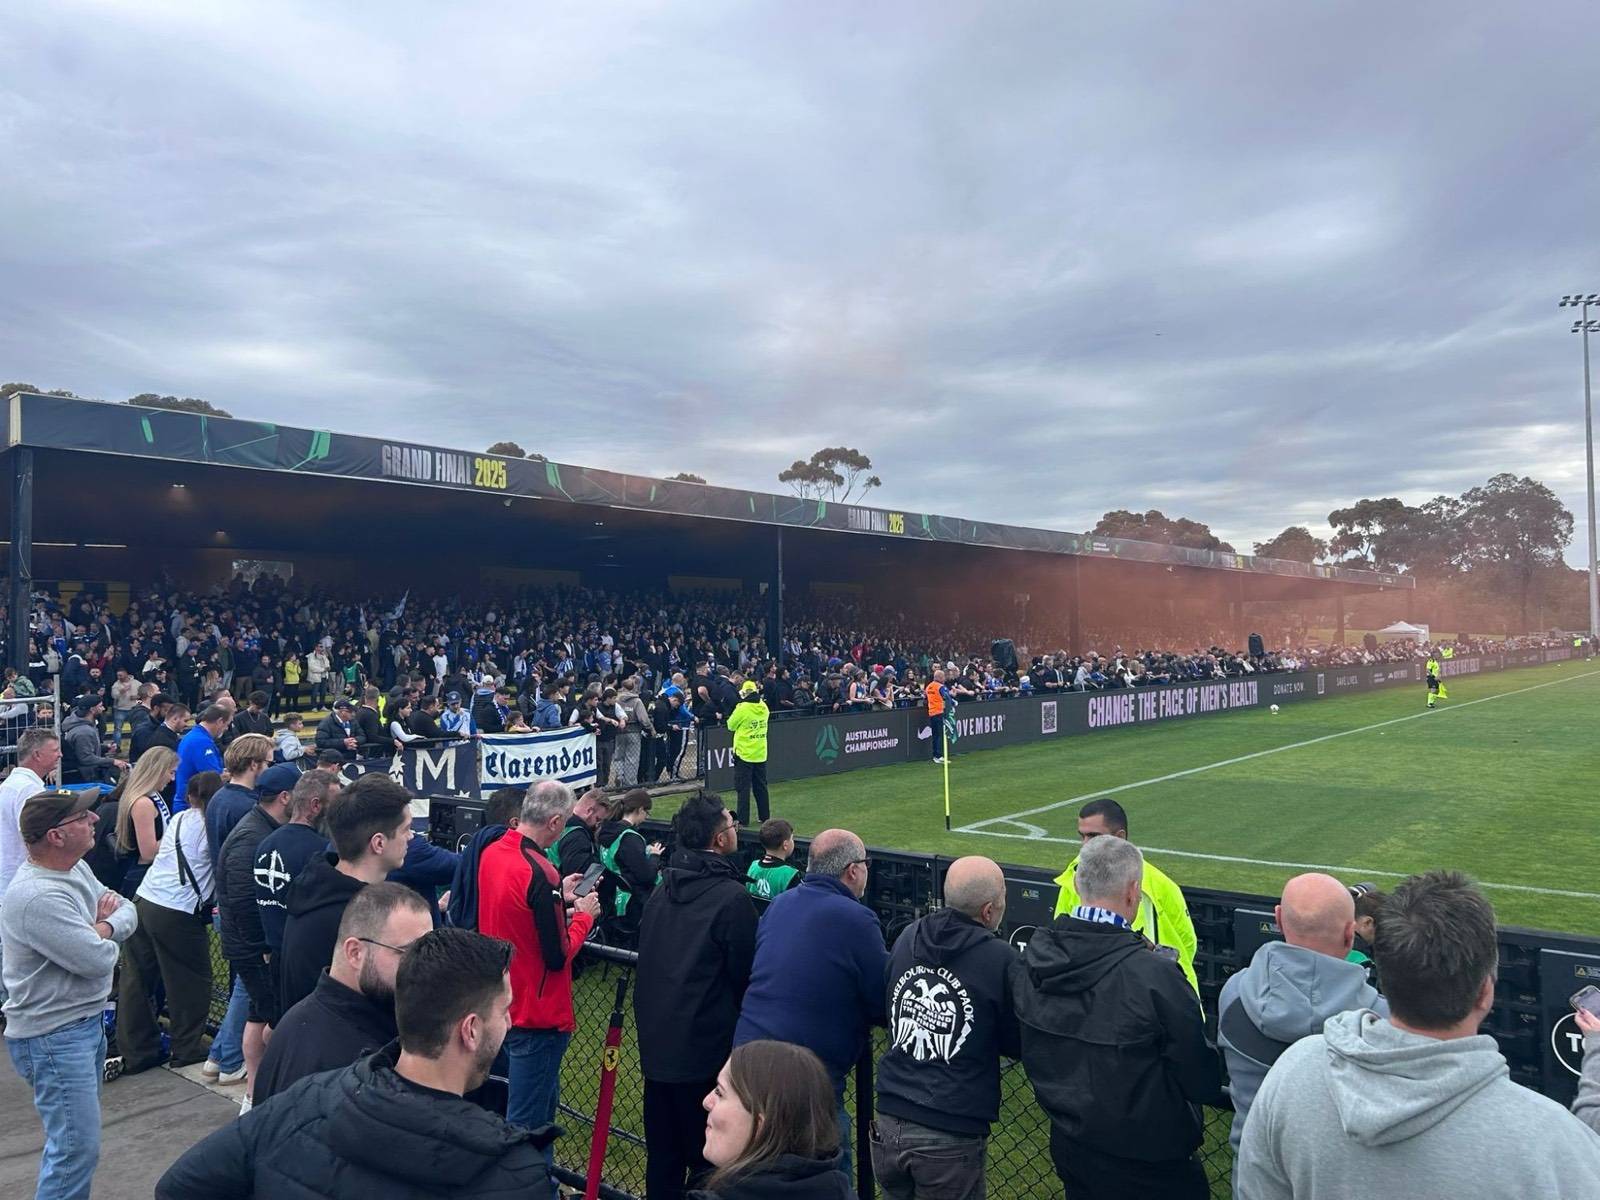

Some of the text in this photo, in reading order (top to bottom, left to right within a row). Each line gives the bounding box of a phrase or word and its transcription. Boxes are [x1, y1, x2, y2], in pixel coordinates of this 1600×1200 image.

[382, 445, 507, 489] GRAND FINAL 2025
[848, 508, 904, 534] GRAND FINAL 2025
[1273, 683, 1293, 695] DONATE
[1088, 681, 1258, 728] CHANGE THE FACE OF MEN'S HEALTH
[845, 728, 888, 742] AUSTRALIAN
[956, 714, 1003, 738] OVEMBER
[845, 738, 899, 754] CHAMPIONSHIP
[415, 748, 456, 791] M
[485, 744, 594, 779] Clarendon
[892, 965, 974, 1023] MELBOURNE CLUB PAOK
[903, 1005, 948, 1028] THE POWER
[914, 1003, 925, 1012] MY
[926, 1009, 952, 1023] MIND
[916, 1016, 936, 1030] FIND
